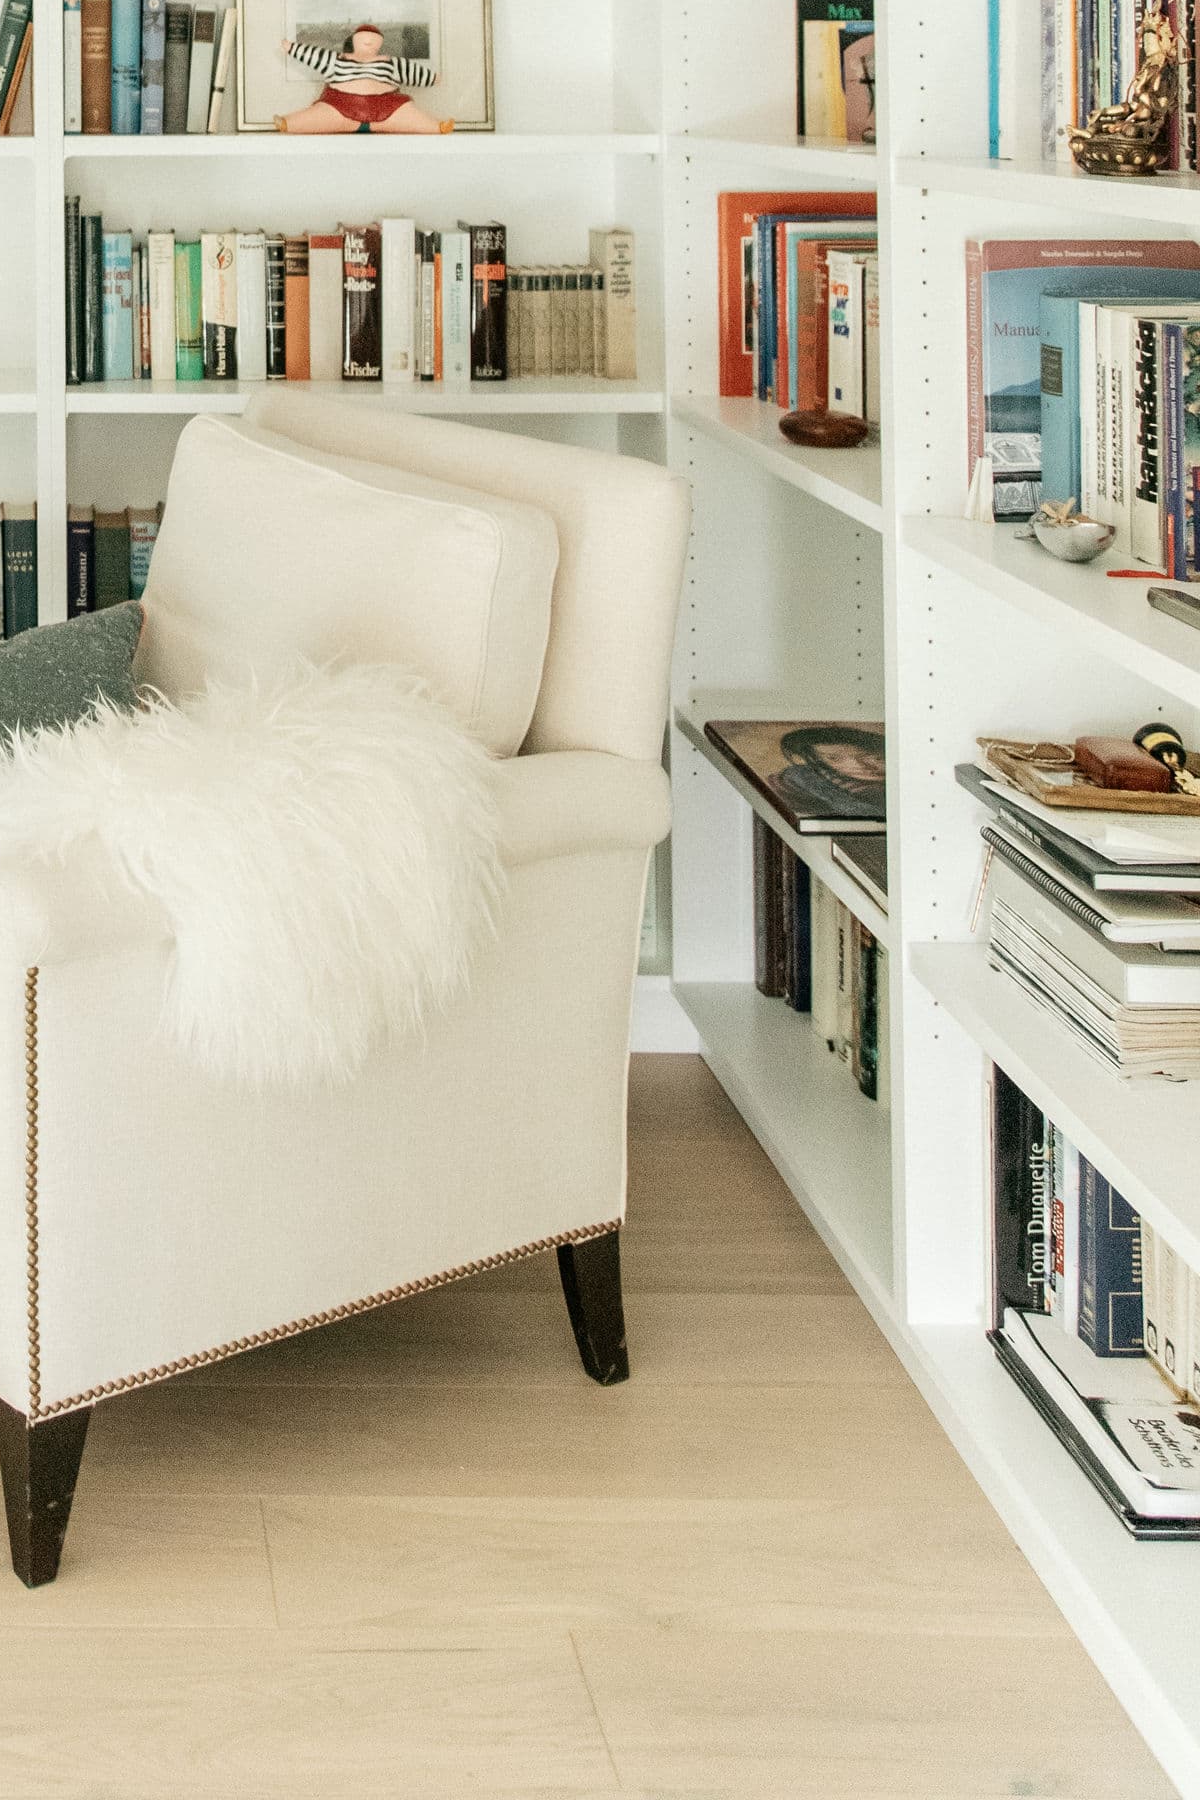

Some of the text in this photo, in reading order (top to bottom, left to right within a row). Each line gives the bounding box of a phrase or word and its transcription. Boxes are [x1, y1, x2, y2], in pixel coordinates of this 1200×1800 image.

[345, 232, 365, 249] Alex
[970, 278, 979, 333] Manual
[994, 321, 1041, 337] Manua
[215, 326, 226, 376] Hans Habe
[969, 351, 980, 418] Standard
[1135, 320, 1159, 504] hartnäckig
[76, 551, 87, 607] Resonanz
[1027, 1242, 1042, 1287] Tom
[1128, 1418, 1174, 1468] Schattens
